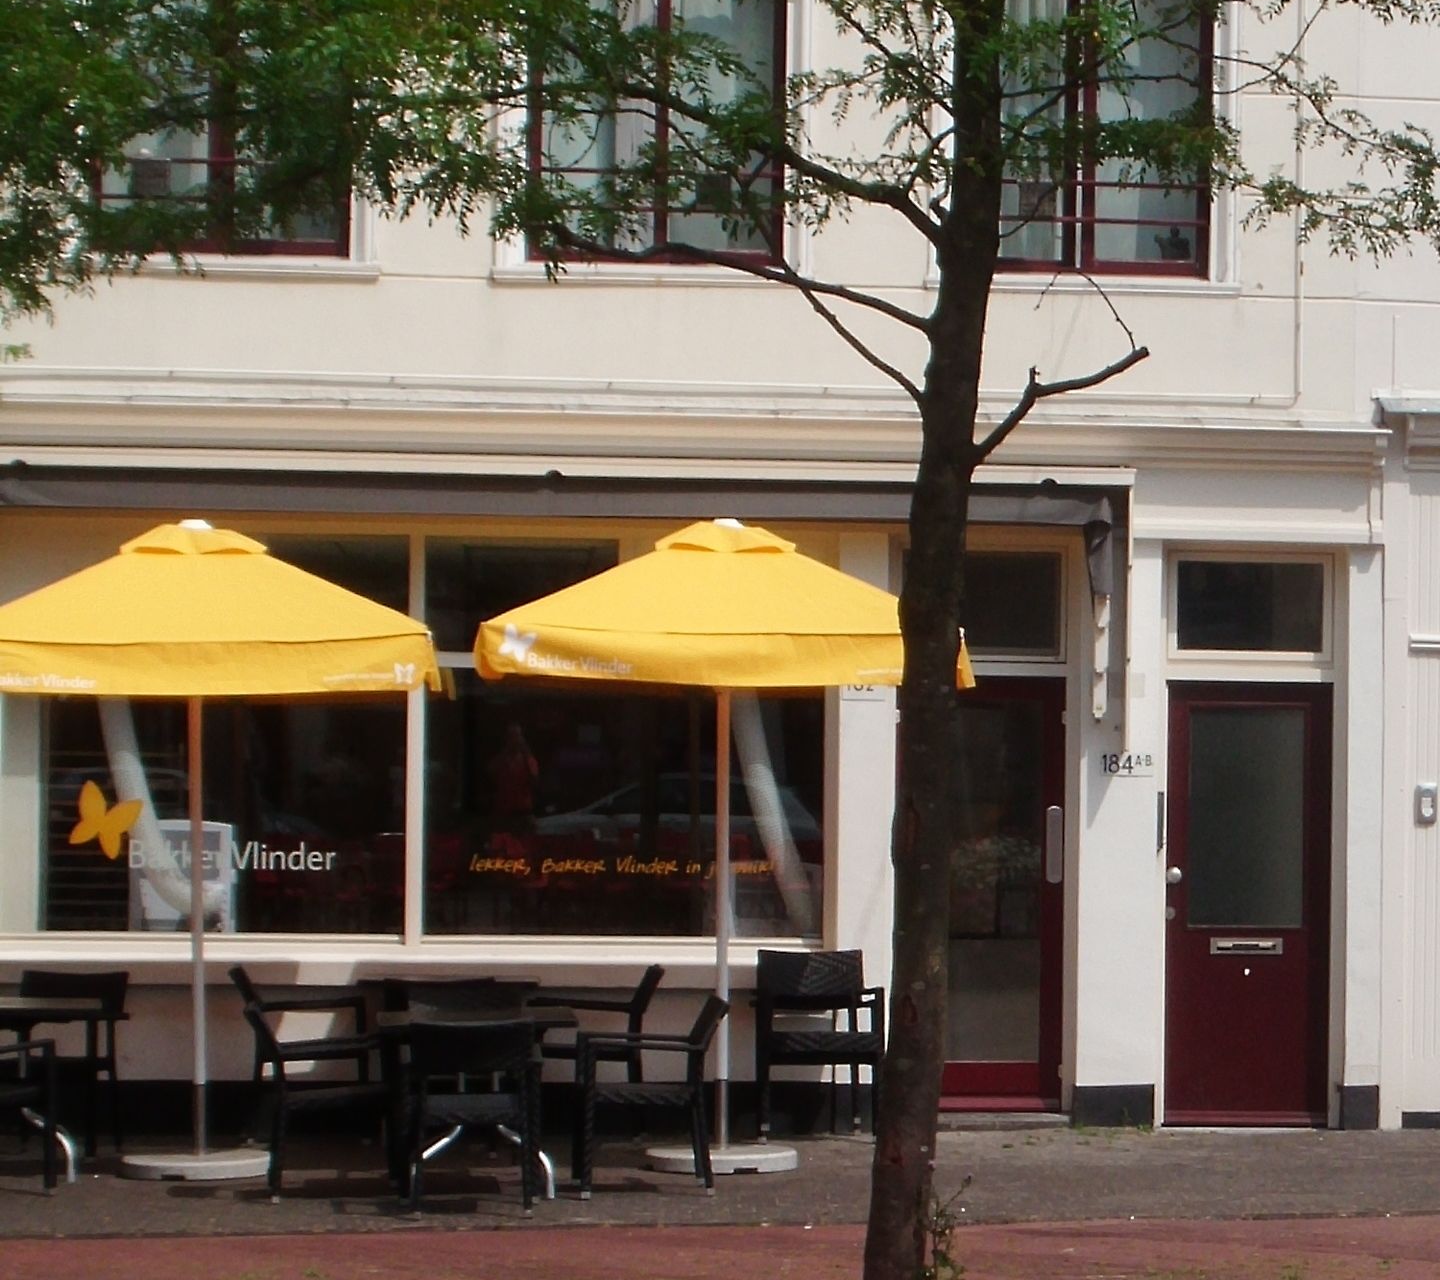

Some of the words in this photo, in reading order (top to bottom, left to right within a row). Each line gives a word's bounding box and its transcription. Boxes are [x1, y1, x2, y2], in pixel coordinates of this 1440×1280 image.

[528, 652, 576, 671] Bakker
[580, 656, 633, 674] Vlinder
[41, 673, 97, 689] Vlinder
[1102, 754, 1134, 774] 184
[230, 841, 337, 870] Vlinder
